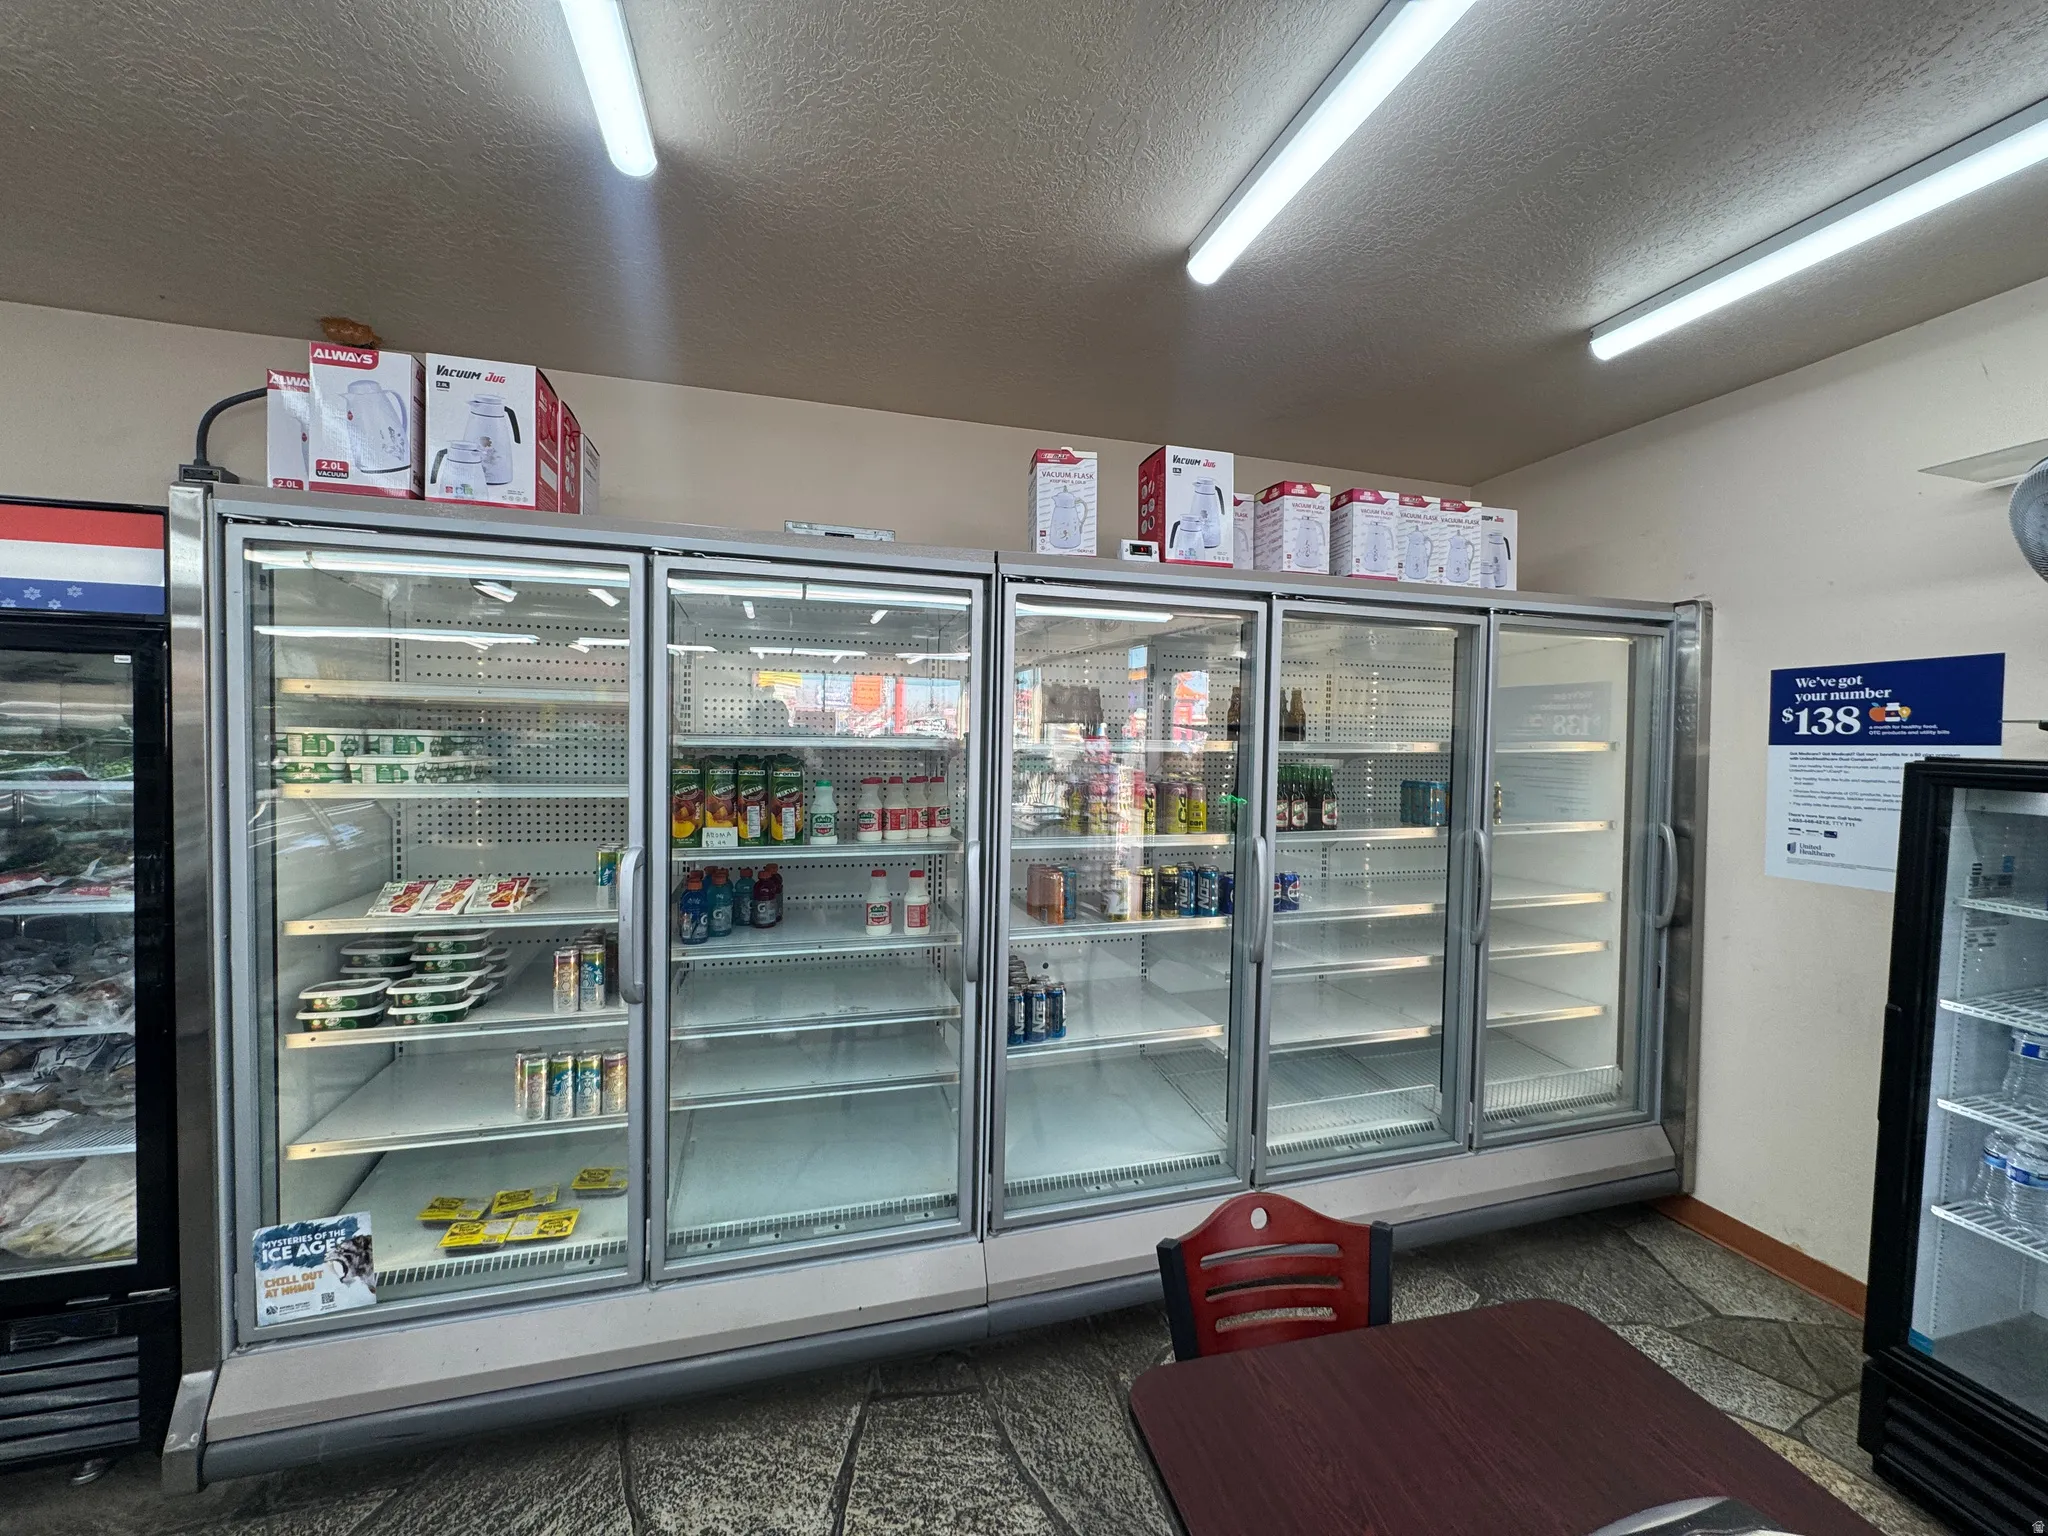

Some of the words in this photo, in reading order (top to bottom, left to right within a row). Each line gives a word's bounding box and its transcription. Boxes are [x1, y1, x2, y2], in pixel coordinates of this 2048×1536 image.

[314, 348, 373, 365] ALWAYS
[270, 374, 310, 387] ALWA
[322, 461, 344, 470] 2.0L
[1042, 471, 1072, 479] VACUUM
[1074, 472, 1095, 480] FLASK
[278, 480, 299, 488] 2.0L
[1795, 676, 1837, 688] We've
[1838, 675, 1863, 689] got
[1794, 692, 1828, 704] your
[1830, 688, 1892, 701] number
[1782, 706, 1861, 735] $138
[1800, 843, 1822, 851] United
[1800, 849, 1836, 858] Healthcare
[1180, 878, 1188, 908] NOS
[1198, 876, 1210, 909] NOS
[262, 1235, 313, 1250] MYSTERIES
[314, 1232, 327, 1241] OF
[329, 1229, 346, 1237] THE
[262, 1246, 293, 1264] ICE
[264, 1276, 300, 1289] CHILL
[301, 1270, 324, 1281] OUT
[264, 1288, 279, 1299] AT
